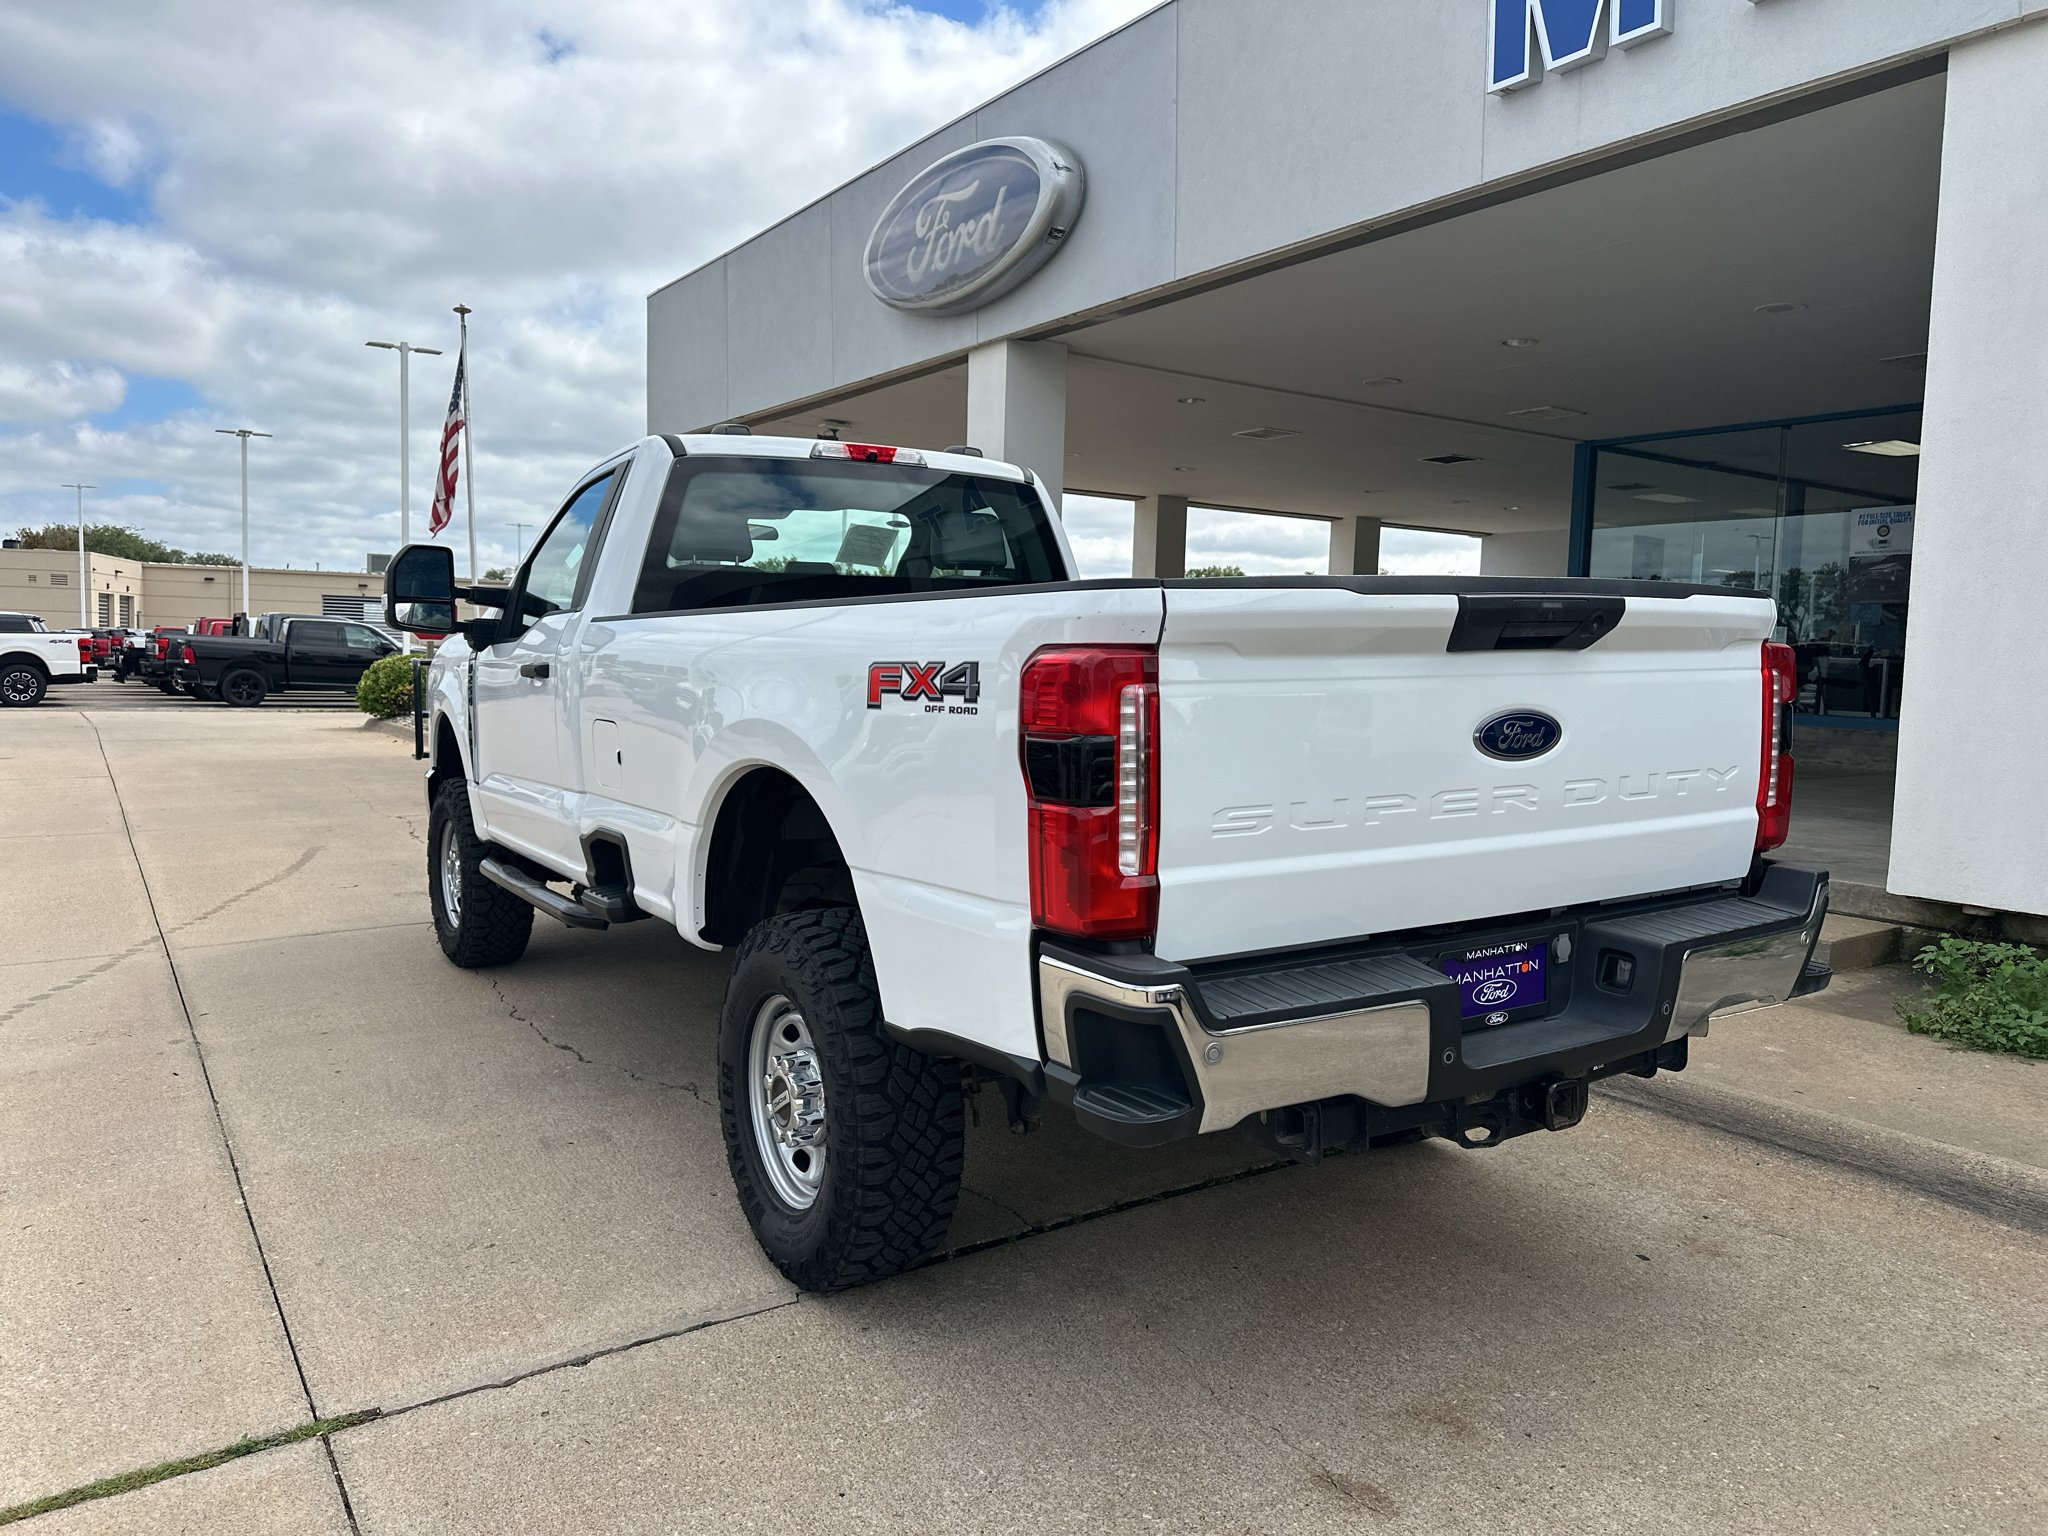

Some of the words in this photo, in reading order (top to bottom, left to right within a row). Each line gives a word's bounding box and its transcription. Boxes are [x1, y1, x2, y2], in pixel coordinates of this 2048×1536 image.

[908, 178, 1008, 283] Ford
[1889, 516, 1913, 525] QUALITY
[867, 661, 981, 710] FX4
[924, 705, 946, 713] OFF
[949, 705, 979, 715] ROAD
[1498, 720, 1546, 750] Ford
[1212, 784, 1539, 839] SUPER
[1563, 765, 1739, 806] DUTY
[1480, 982, 1509, 1002] Ford
[1489, 1012, 1505, 1024] Ford
[722, 1061, 765, 1226] WRANGLER
